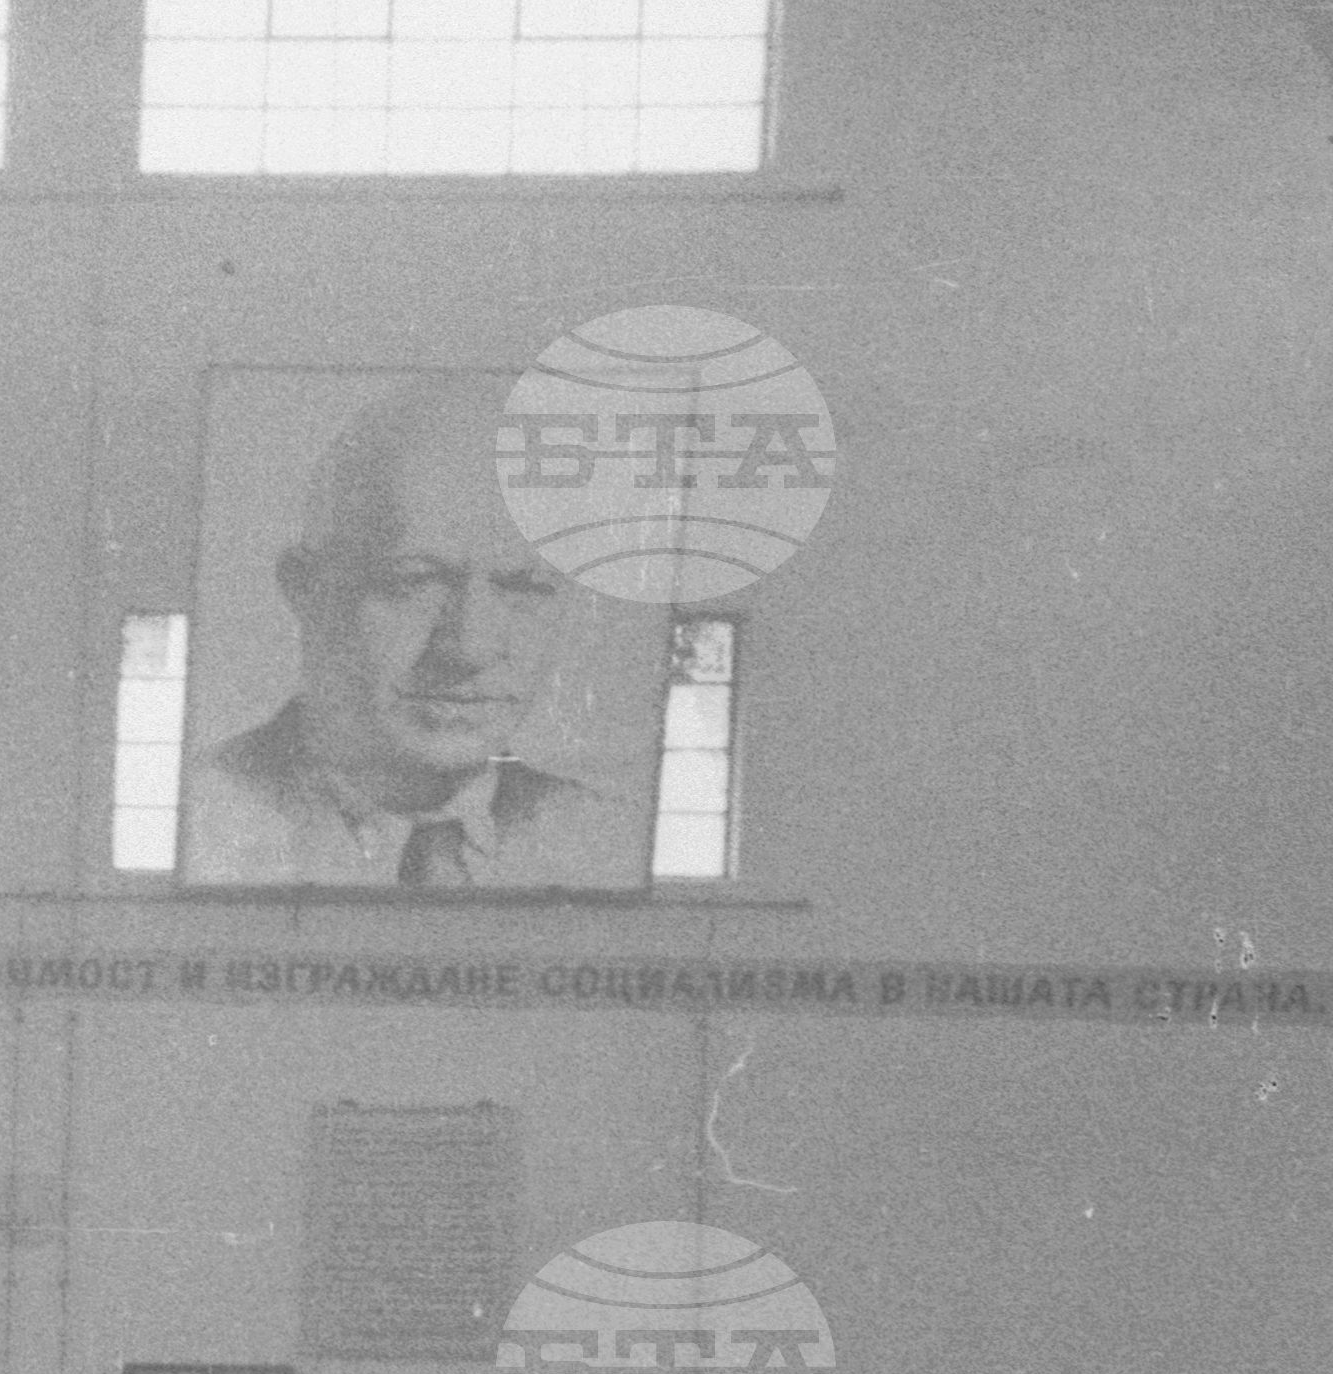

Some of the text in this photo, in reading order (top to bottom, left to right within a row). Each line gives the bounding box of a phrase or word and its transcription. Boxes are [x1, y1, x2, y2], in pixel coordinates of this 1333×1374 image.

[179, 960, 207, 992] И
[225, 959, 521, 1000] ИЗГРАЖДАНЕ
[539, 964, 858, 1004] СОЦИАЛИЗМА
[879, 971, 906, 1006] В
[925, 973, 1113, 1009] НАШАТА
